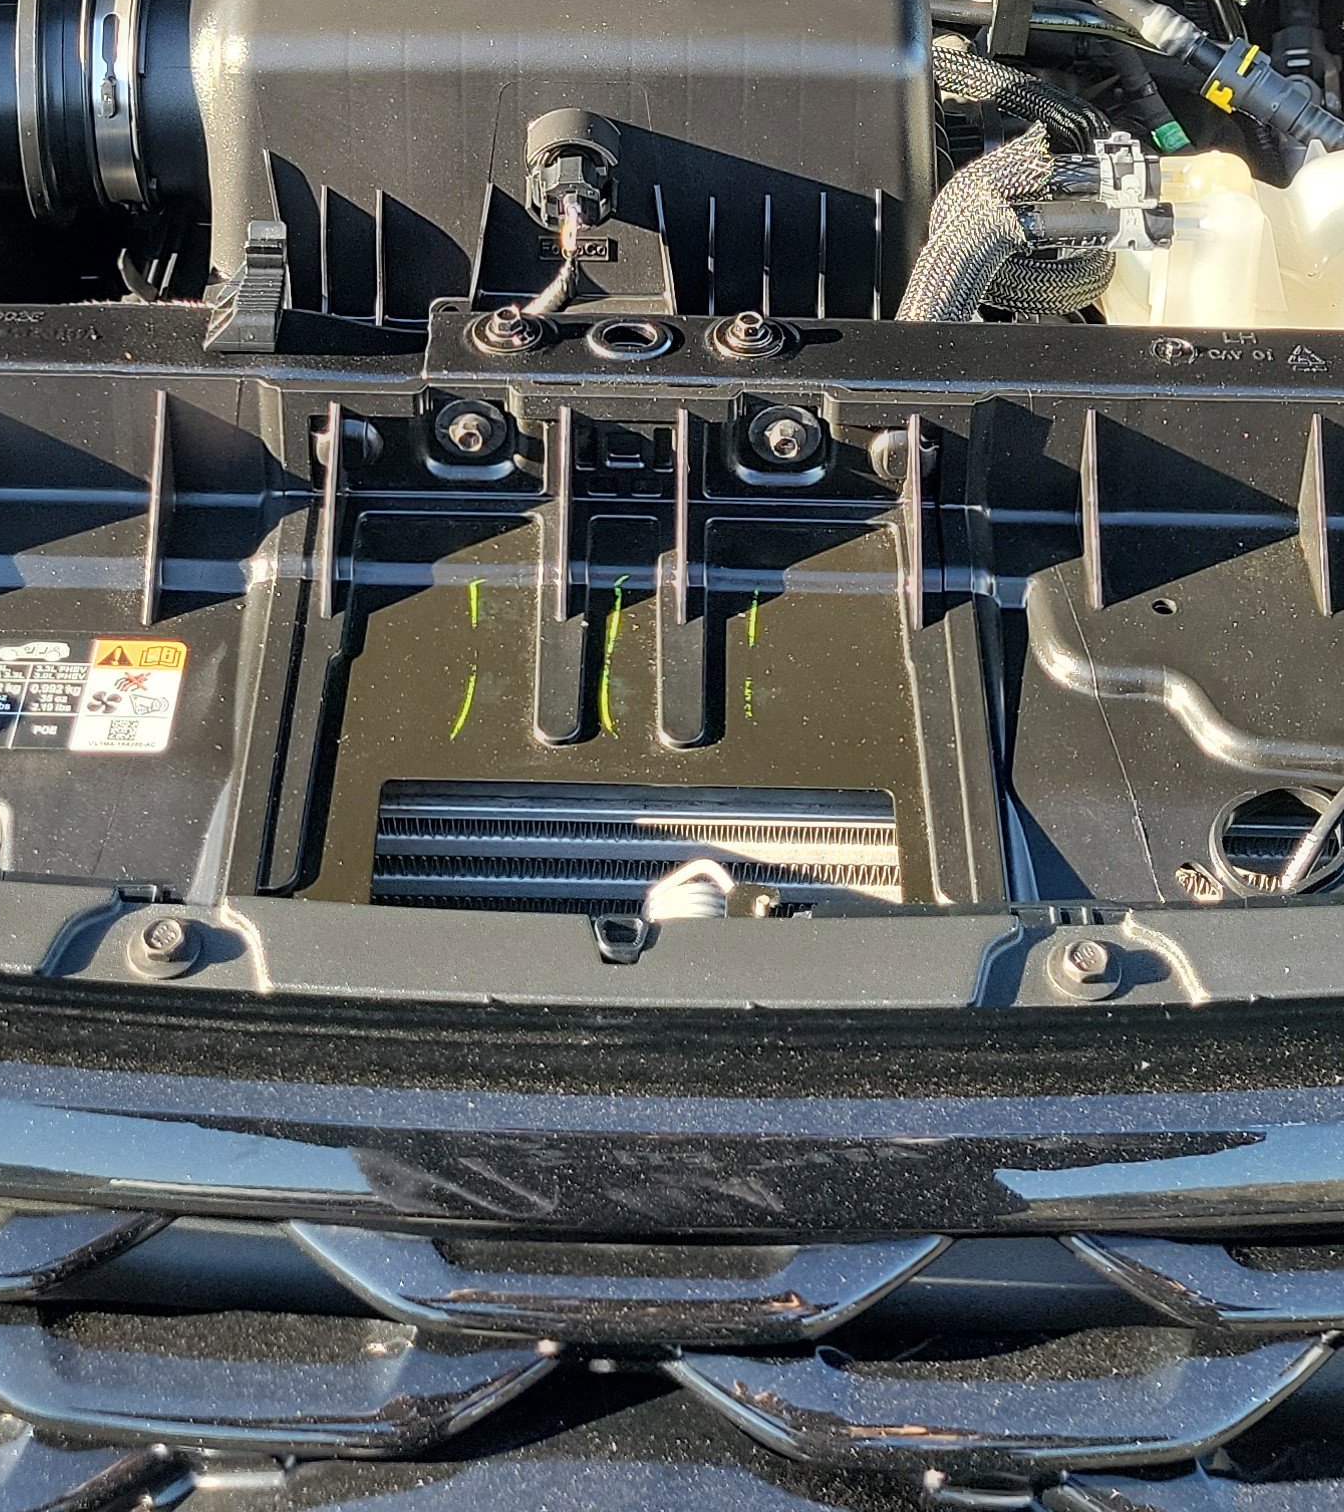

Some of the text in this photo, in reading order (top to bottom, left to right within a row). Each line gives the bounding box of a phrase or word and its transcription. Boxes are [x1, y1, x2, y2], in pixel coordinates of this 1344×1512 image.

[1222, 331, 1258, 345] LH
[4, 683, 21, 695] kg
[65, 685, 82, 696] kg
[39, 694, 68, 703] 35 oz
[30, 702, 72, 712] 2.19 lbs
[32, 724, 58, 736] POE
